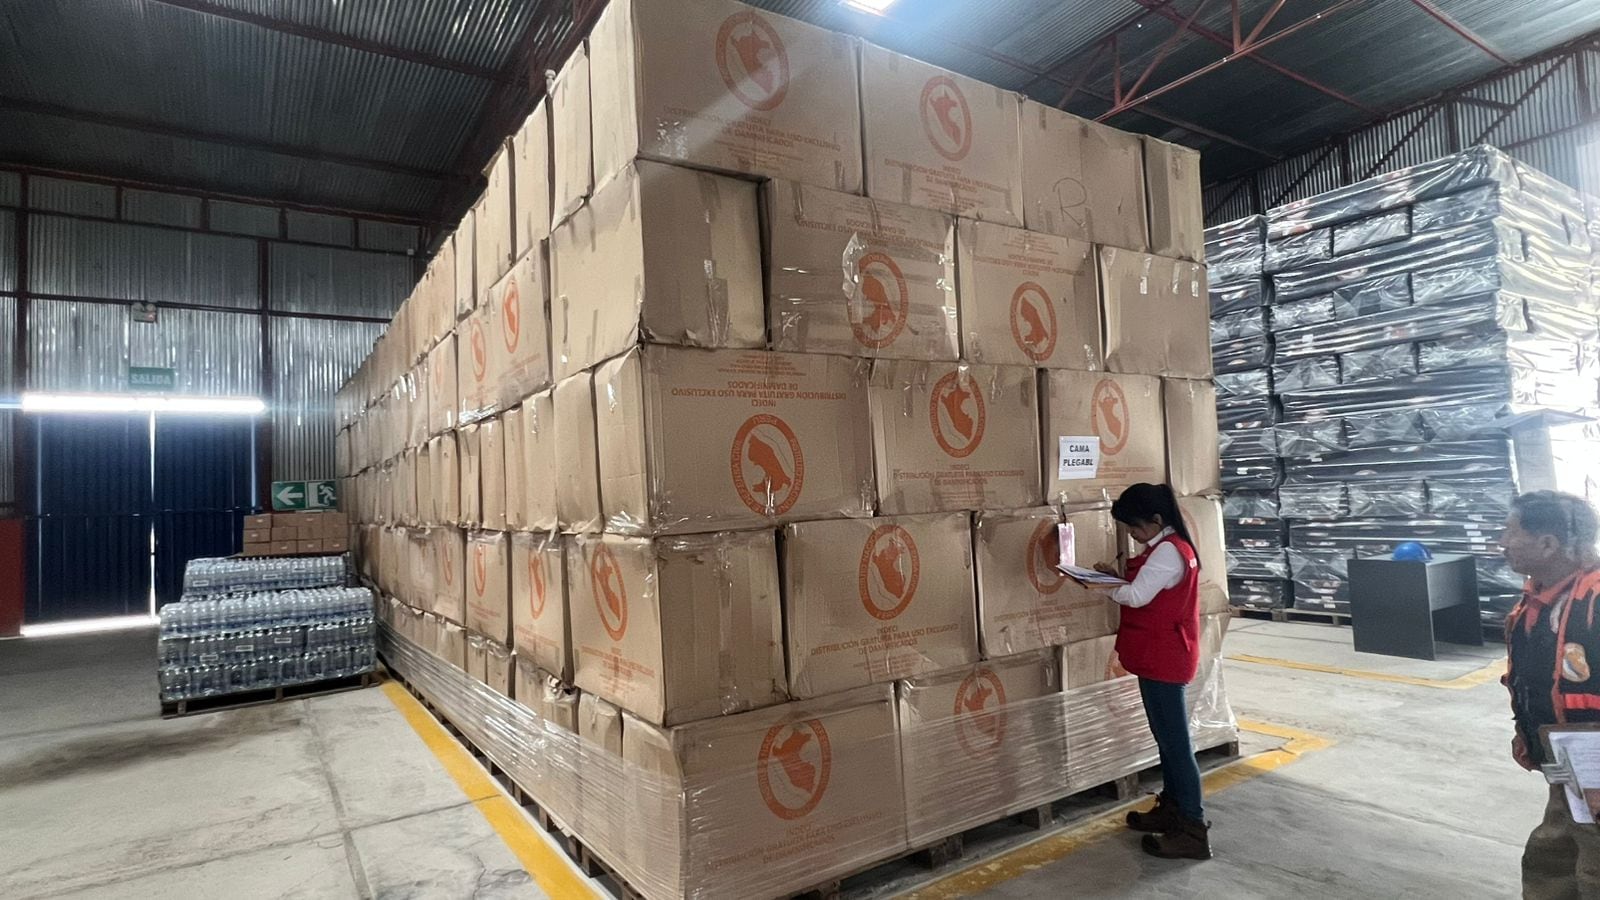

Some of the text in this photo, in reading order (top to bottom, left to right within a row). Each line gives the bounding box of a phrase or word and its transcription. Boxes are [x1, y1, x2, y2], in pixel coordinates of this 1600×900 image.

[131, 374, 171, 385] SALIDA
[788, 383, 799, 391] DE
[671, 388, 716, 397] EXCLUSIVO
[718, 389, 735, 398] USO
[737, 390, 757, 399] PARA
[758, 390, 795, 400] GRATUITA
[751, 399, 776, 407] INDECI
[1069, 444, 1090, 453] CAMA
[912, 629, 925, 638] USO
